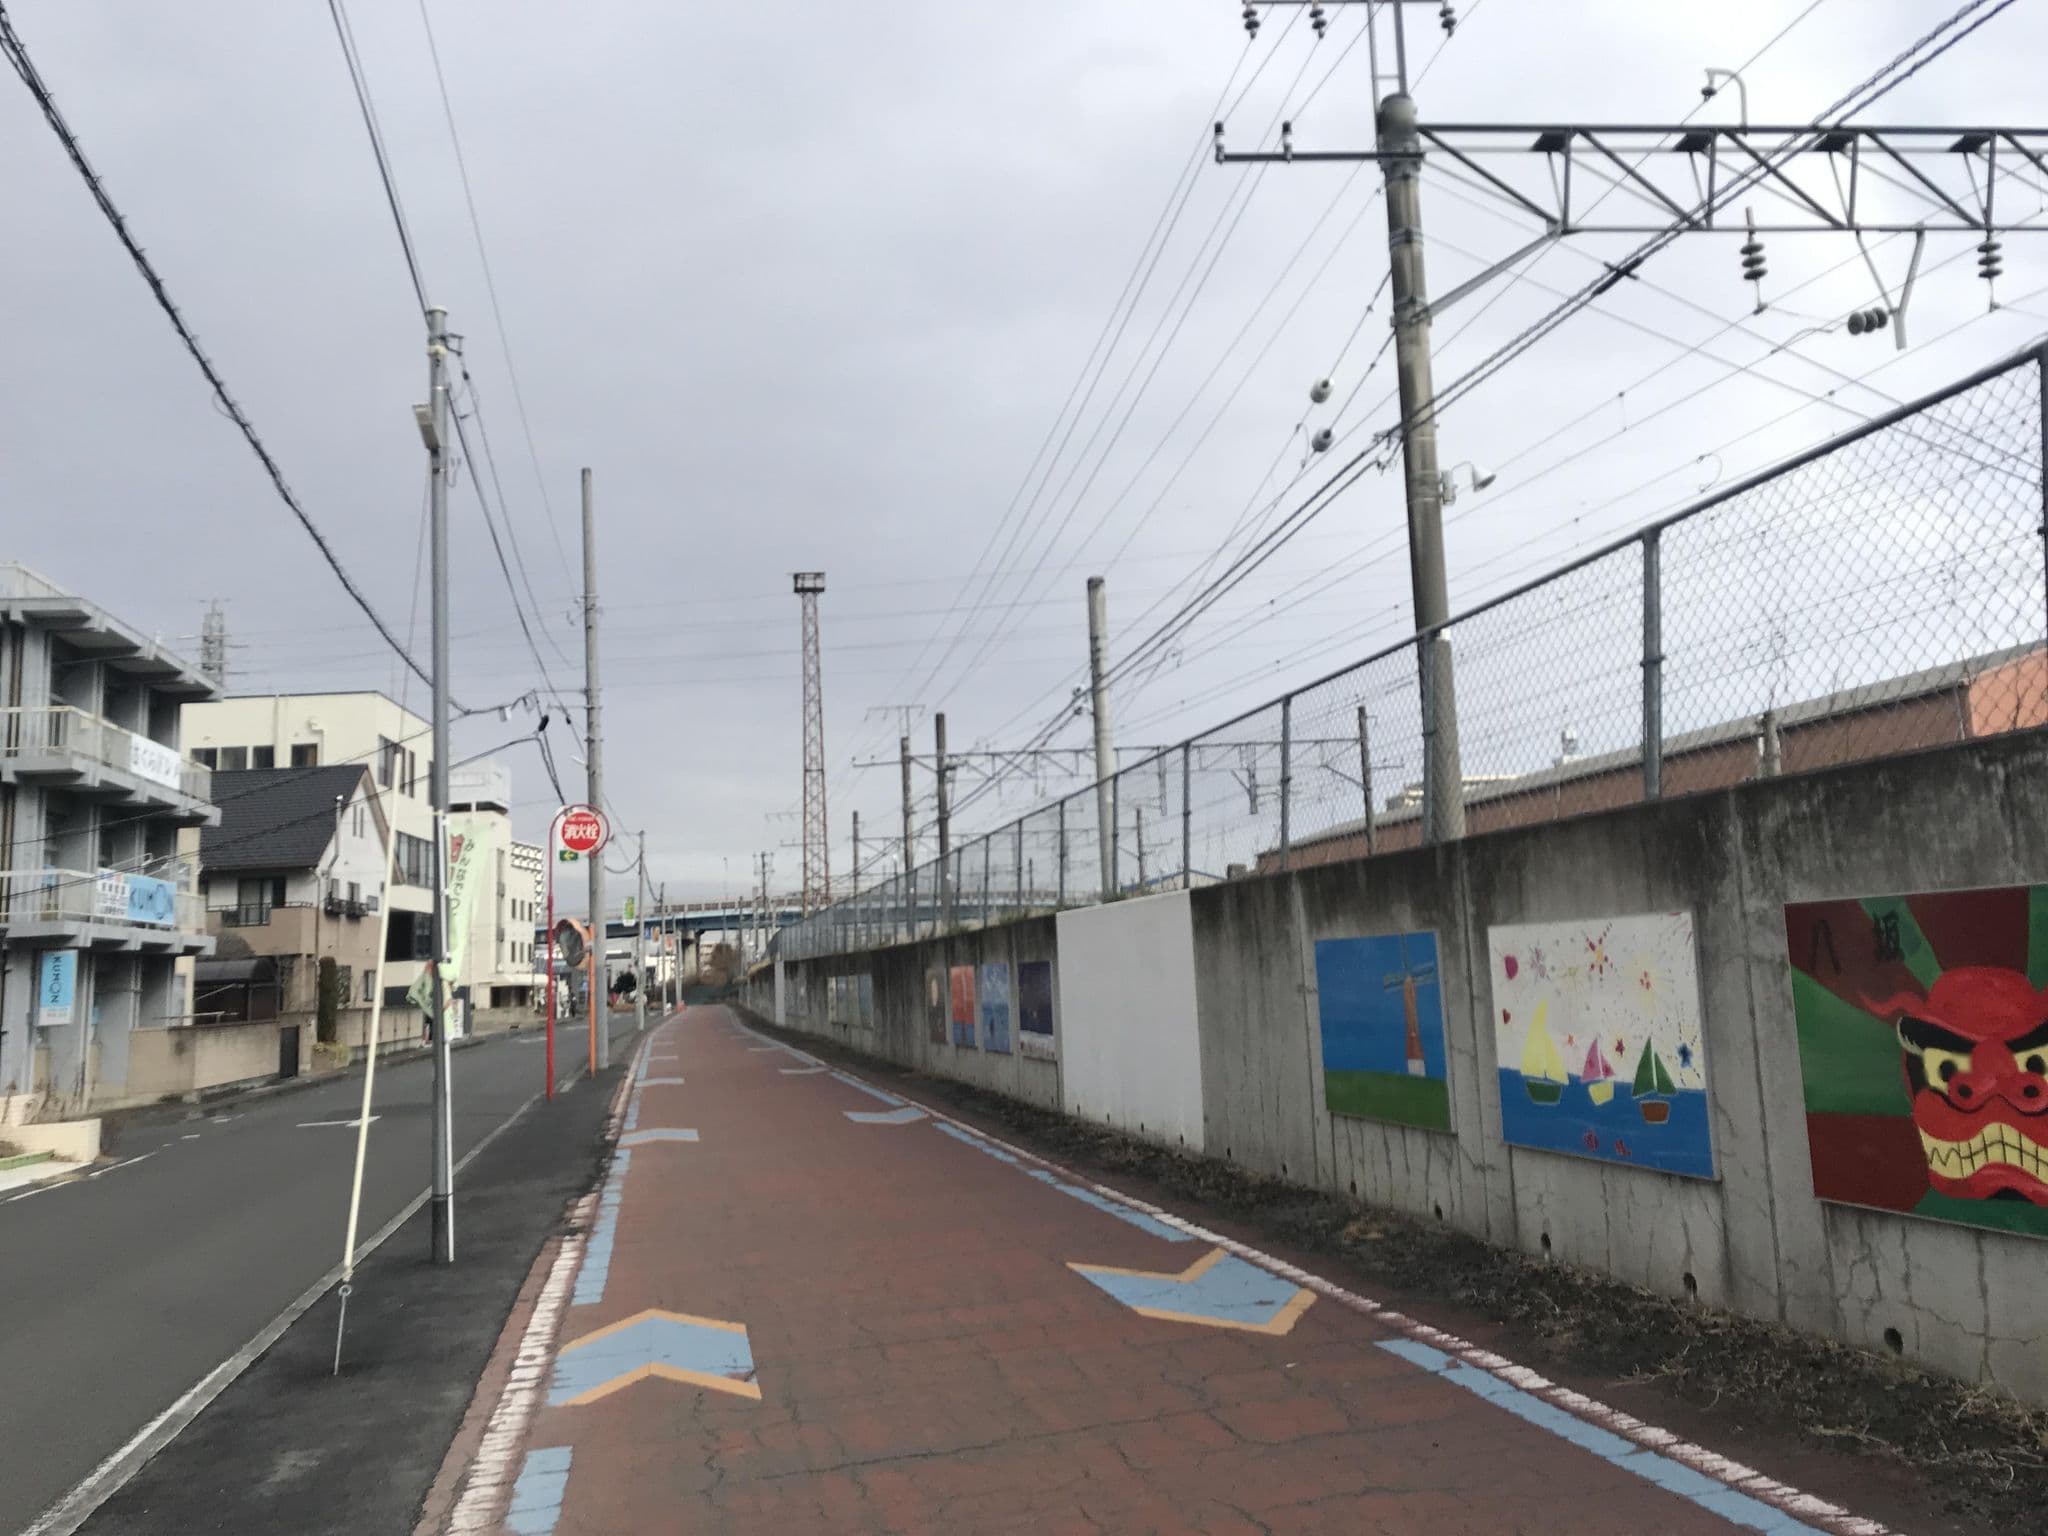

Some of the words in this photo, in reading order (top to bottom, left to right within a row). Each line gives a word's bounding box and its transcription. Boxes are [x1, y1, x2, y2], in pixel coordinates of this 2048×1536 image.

[564, 823, 599, 840] 消火栓
[129, 883, 175, 920] KUMON
[48, 955, 64, 1004] KUMON
